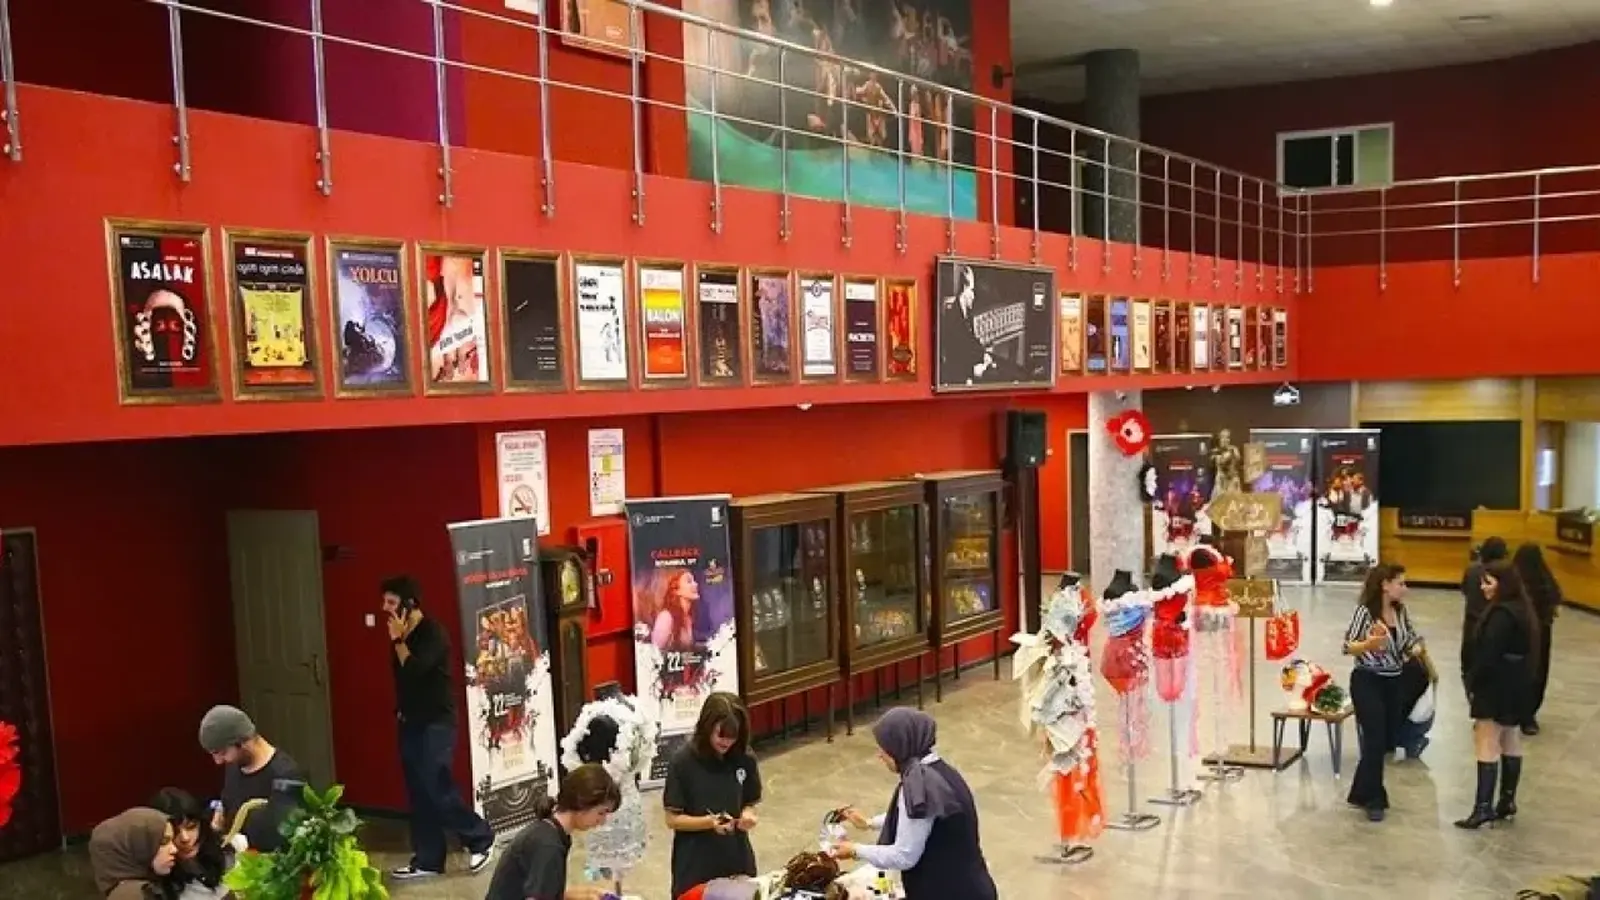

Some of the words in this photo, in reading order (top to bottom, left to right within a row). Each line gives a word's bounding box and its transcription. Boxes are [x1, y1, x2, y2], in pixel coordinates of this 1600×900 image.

[131, 261, 194, 284] ASALAK
[350, 266, 398, 284] YOLCU
[647, 308, 681, 322] BALON
[650, 547, 701, 560] CALLBACK
[666, 651, 684, 673] 22
[492, 692, 506, 717] 22
